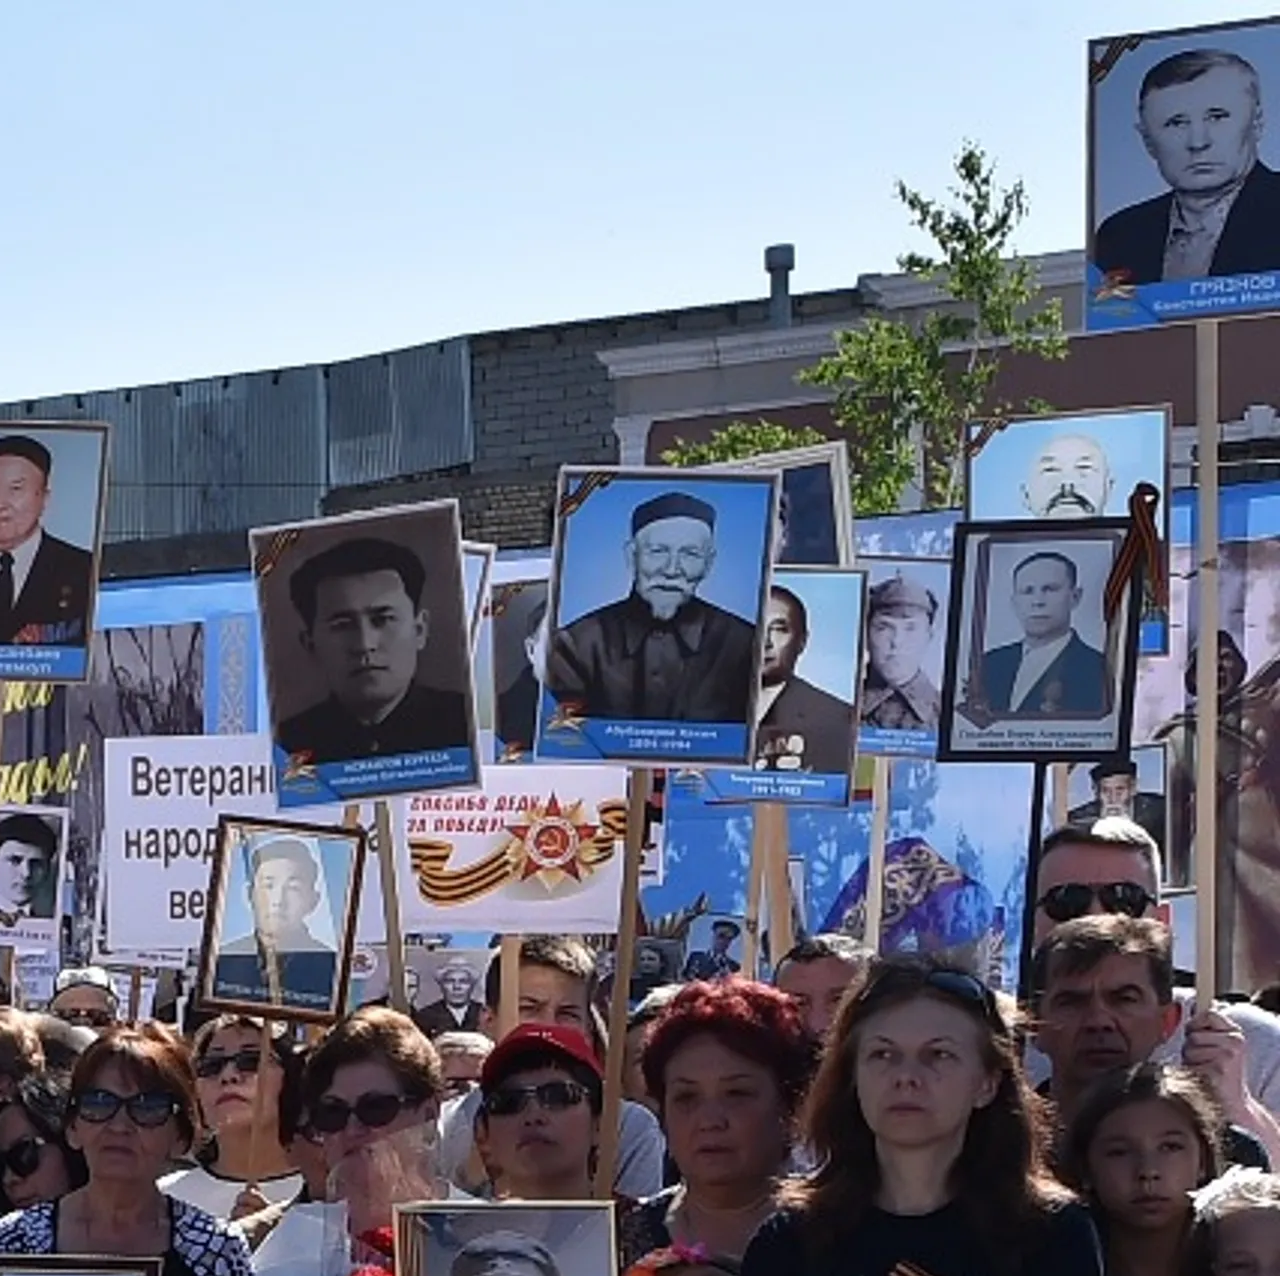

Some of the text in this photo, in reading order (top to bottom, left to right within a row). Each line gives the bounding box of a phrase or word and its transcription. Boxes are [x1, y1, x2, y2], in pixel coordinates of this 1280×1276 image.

[1190, 275, 1277, 297] ГРЯЗНОВ
[130, 755, 274, 806] Ветеран
[409, 795, 488, 812] СПАСИБО
[406, 815, 505, 835] ЗА ПОБЕДУ!
